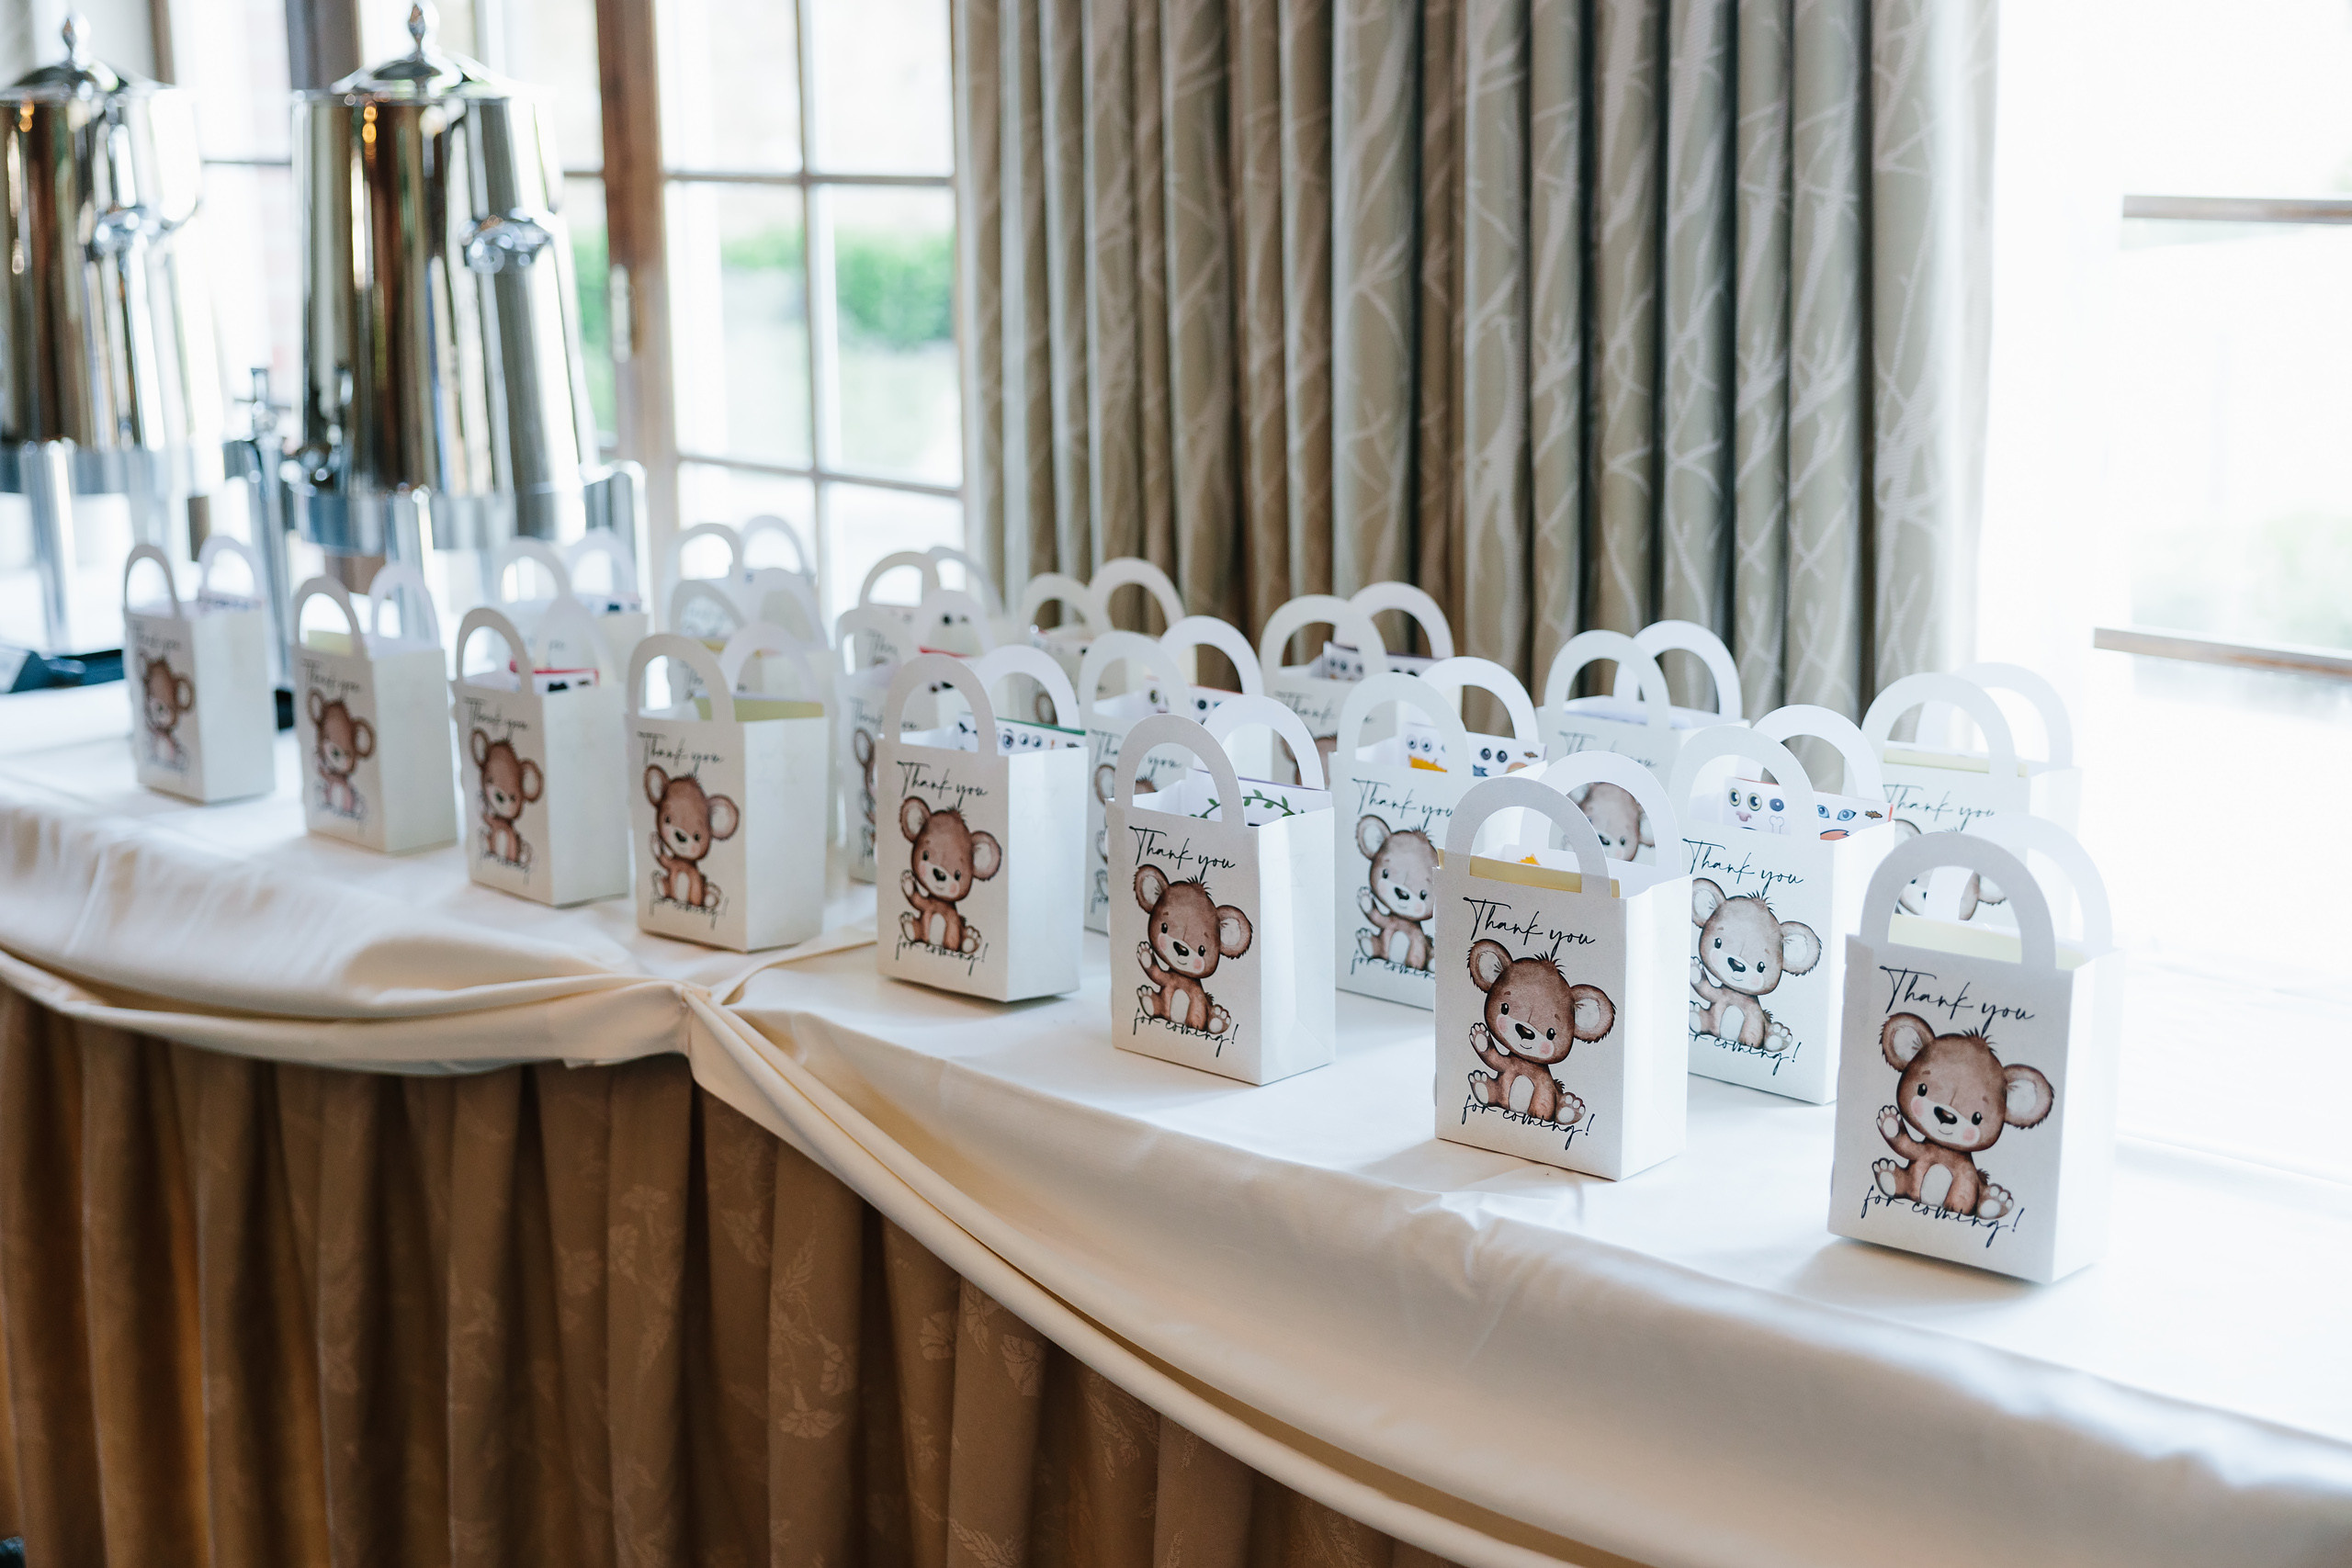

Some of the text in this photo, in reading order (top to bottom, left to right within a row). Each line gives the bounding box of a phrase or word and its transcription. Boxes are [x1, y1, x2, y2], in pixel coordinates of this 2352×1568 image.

[897, 760, 989, 809] Thank you
[1351, 778, 1453, 832] Thank you
[1128, 825, 1237, 883] Thank you
[1682, 837, 1804, 901] Thank you
[1463, 897, 1597, 963] Thank you
[1879, 964, 2036, 1040] Thank you
[1132, 1007, 1240, 1058] for coming!
[1713, 1035, 1803, 1077] coming!
[1461, 1093, 1596, 1151] for coming!
[1860, 1184, 2026, 1249] for coming!
